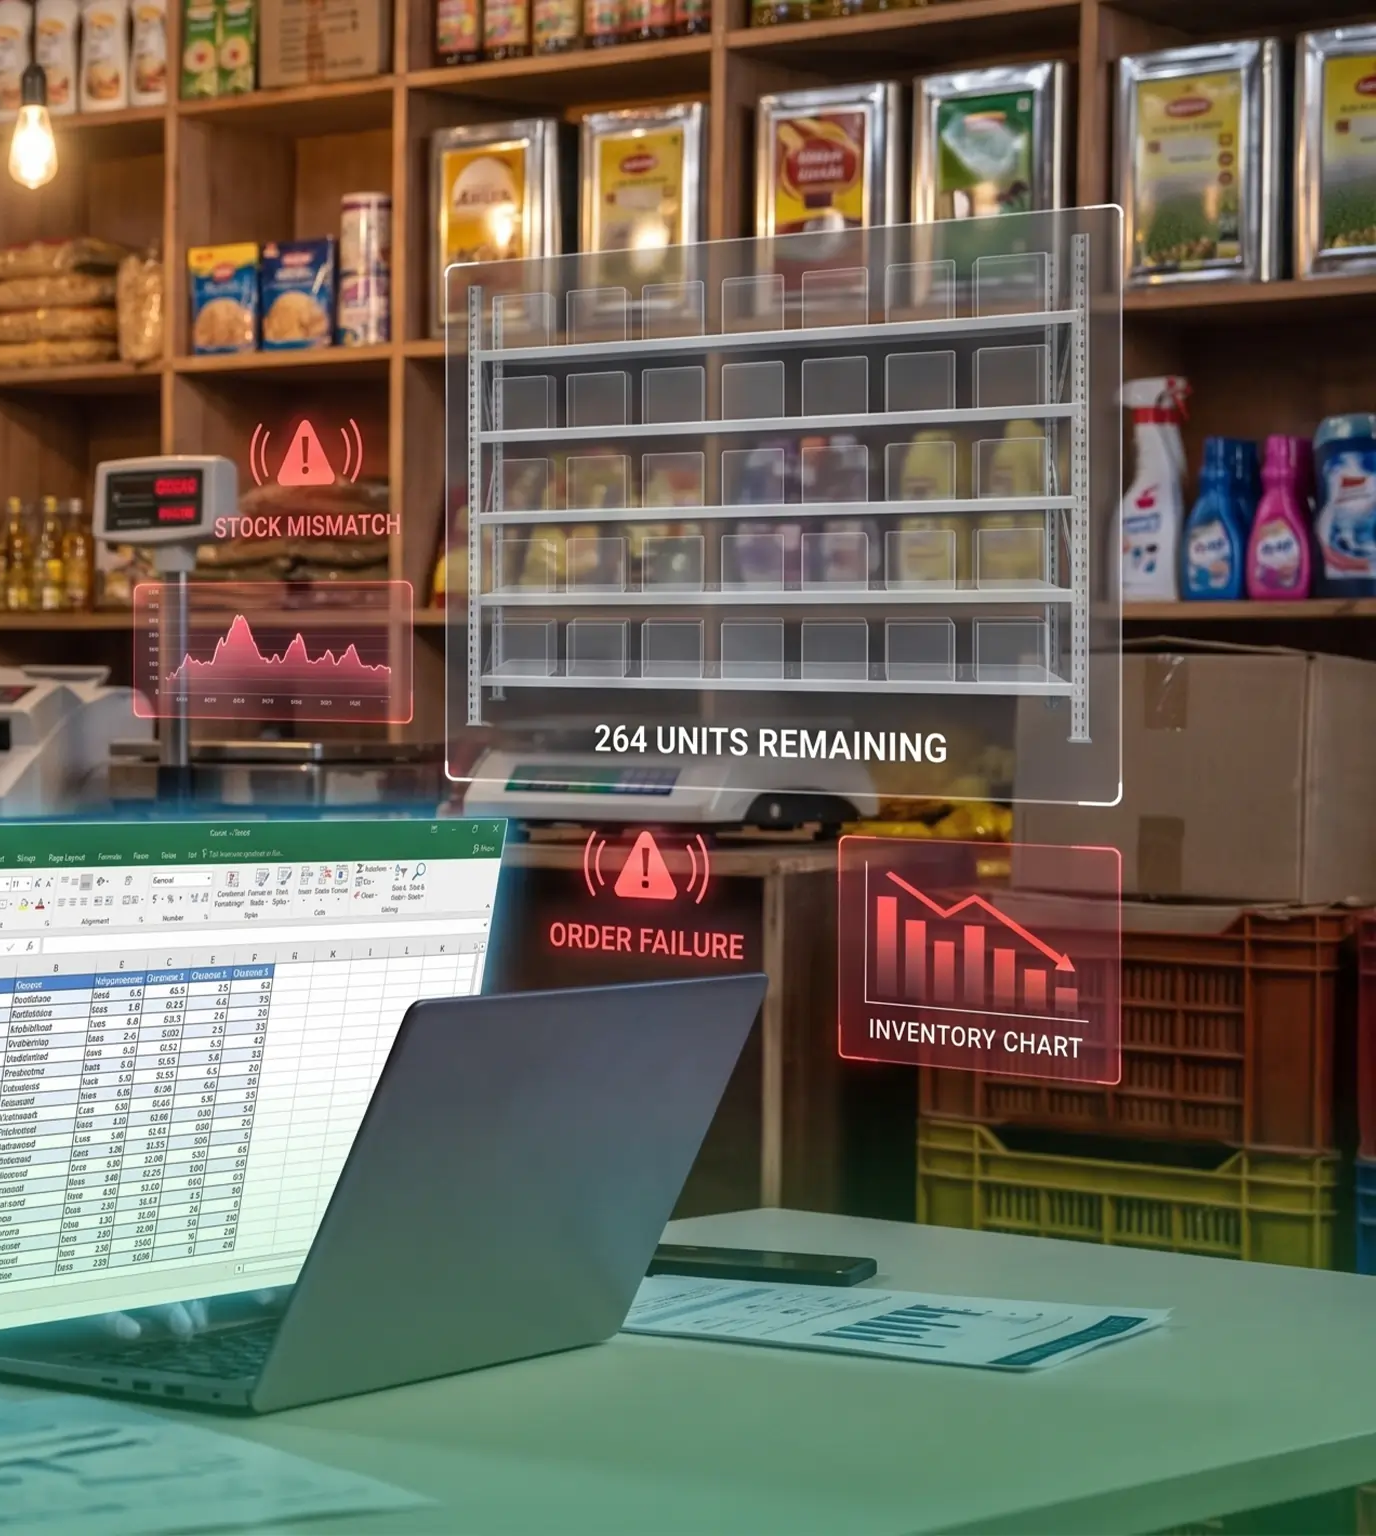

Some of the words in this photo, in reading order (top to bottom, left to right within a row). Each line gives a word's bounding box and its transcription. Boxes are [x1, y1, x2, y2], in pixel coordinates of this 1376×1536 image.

[163, 914, 184, 922] Number
[54, 964, 59, 972] B
[166, 958, 172, 966] C
[248, 1063, 259, 1072] 20
